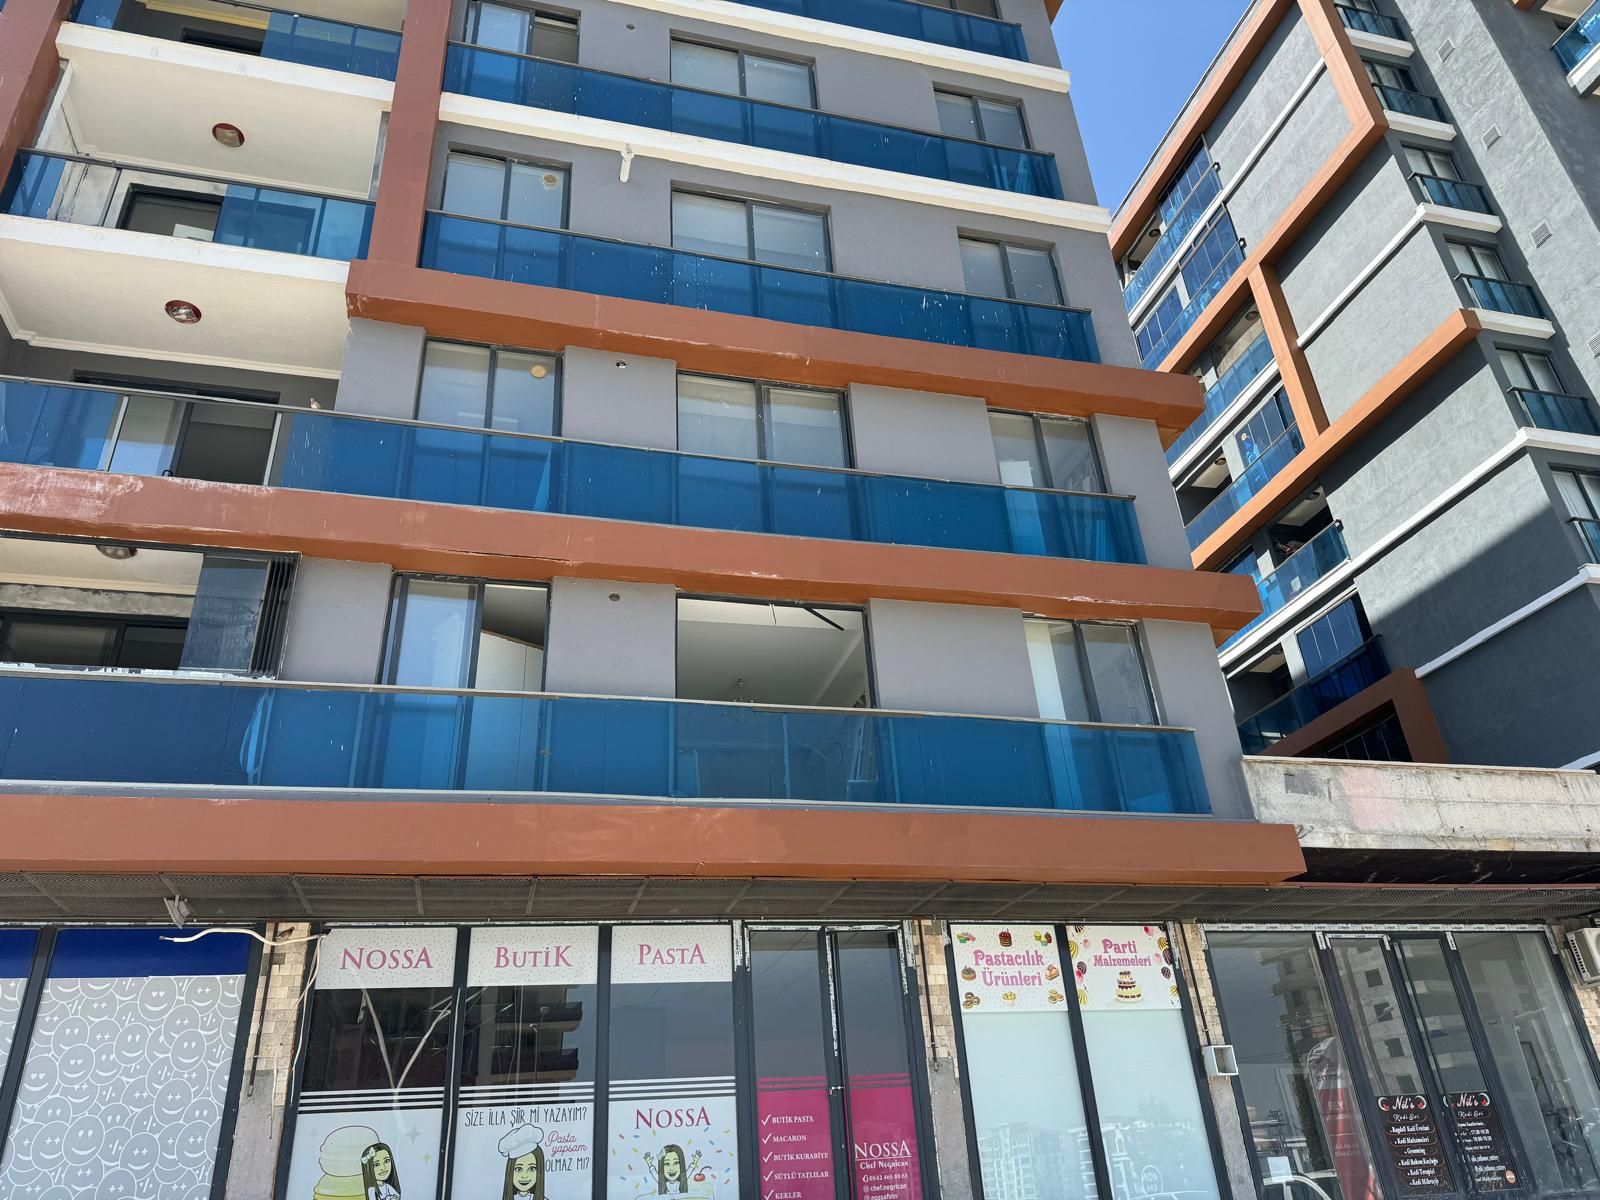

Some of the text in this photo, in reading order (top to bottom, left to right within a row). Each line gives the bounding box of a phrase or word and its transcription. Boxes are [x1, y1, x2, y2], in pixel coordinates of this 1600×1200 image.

[1101, 938, 1138, 954] Parti
[340, 946, 434, 970] NOSSA
[638, 943, 706, 966] PASTA
[973, 949, 1046, 967] Pastacılık
[1093, 954, 1152, 967] Malzemeleri
[981, 967, 1043, 987] Ürünleri
[1392, 1095, 1415, 1110] Nil's
[1457, 1093, 1479, 1107] Nil's
[465, 1109, 484, 1127] SİZE
[488, 1109, 506, 1125] İLLA
[530, 1106, 540, 1124] Mİ
[544, 1106, 588, 1123] YAZAYIM?
[634, 1105, 712, 1129] NOSSA
[772, 1115, 814, 1124] BUTİK PASTA
[545, 1131, 577, 1147] Pasta
[772, 1135, 807, 1143] MACARON
[551, 1144, 589, 1157] yapsam
[773, 1151, 829, 1161] BUTİK KURABİYE
[854, 1139, 912, 1159] NOSSA
[545, 1157, 573, 1173] OLMAZ
[774, 1170, 829, 1181] SÜTLÜ TATLILAR
[775, 1191, 802, 1200] KEKLER
